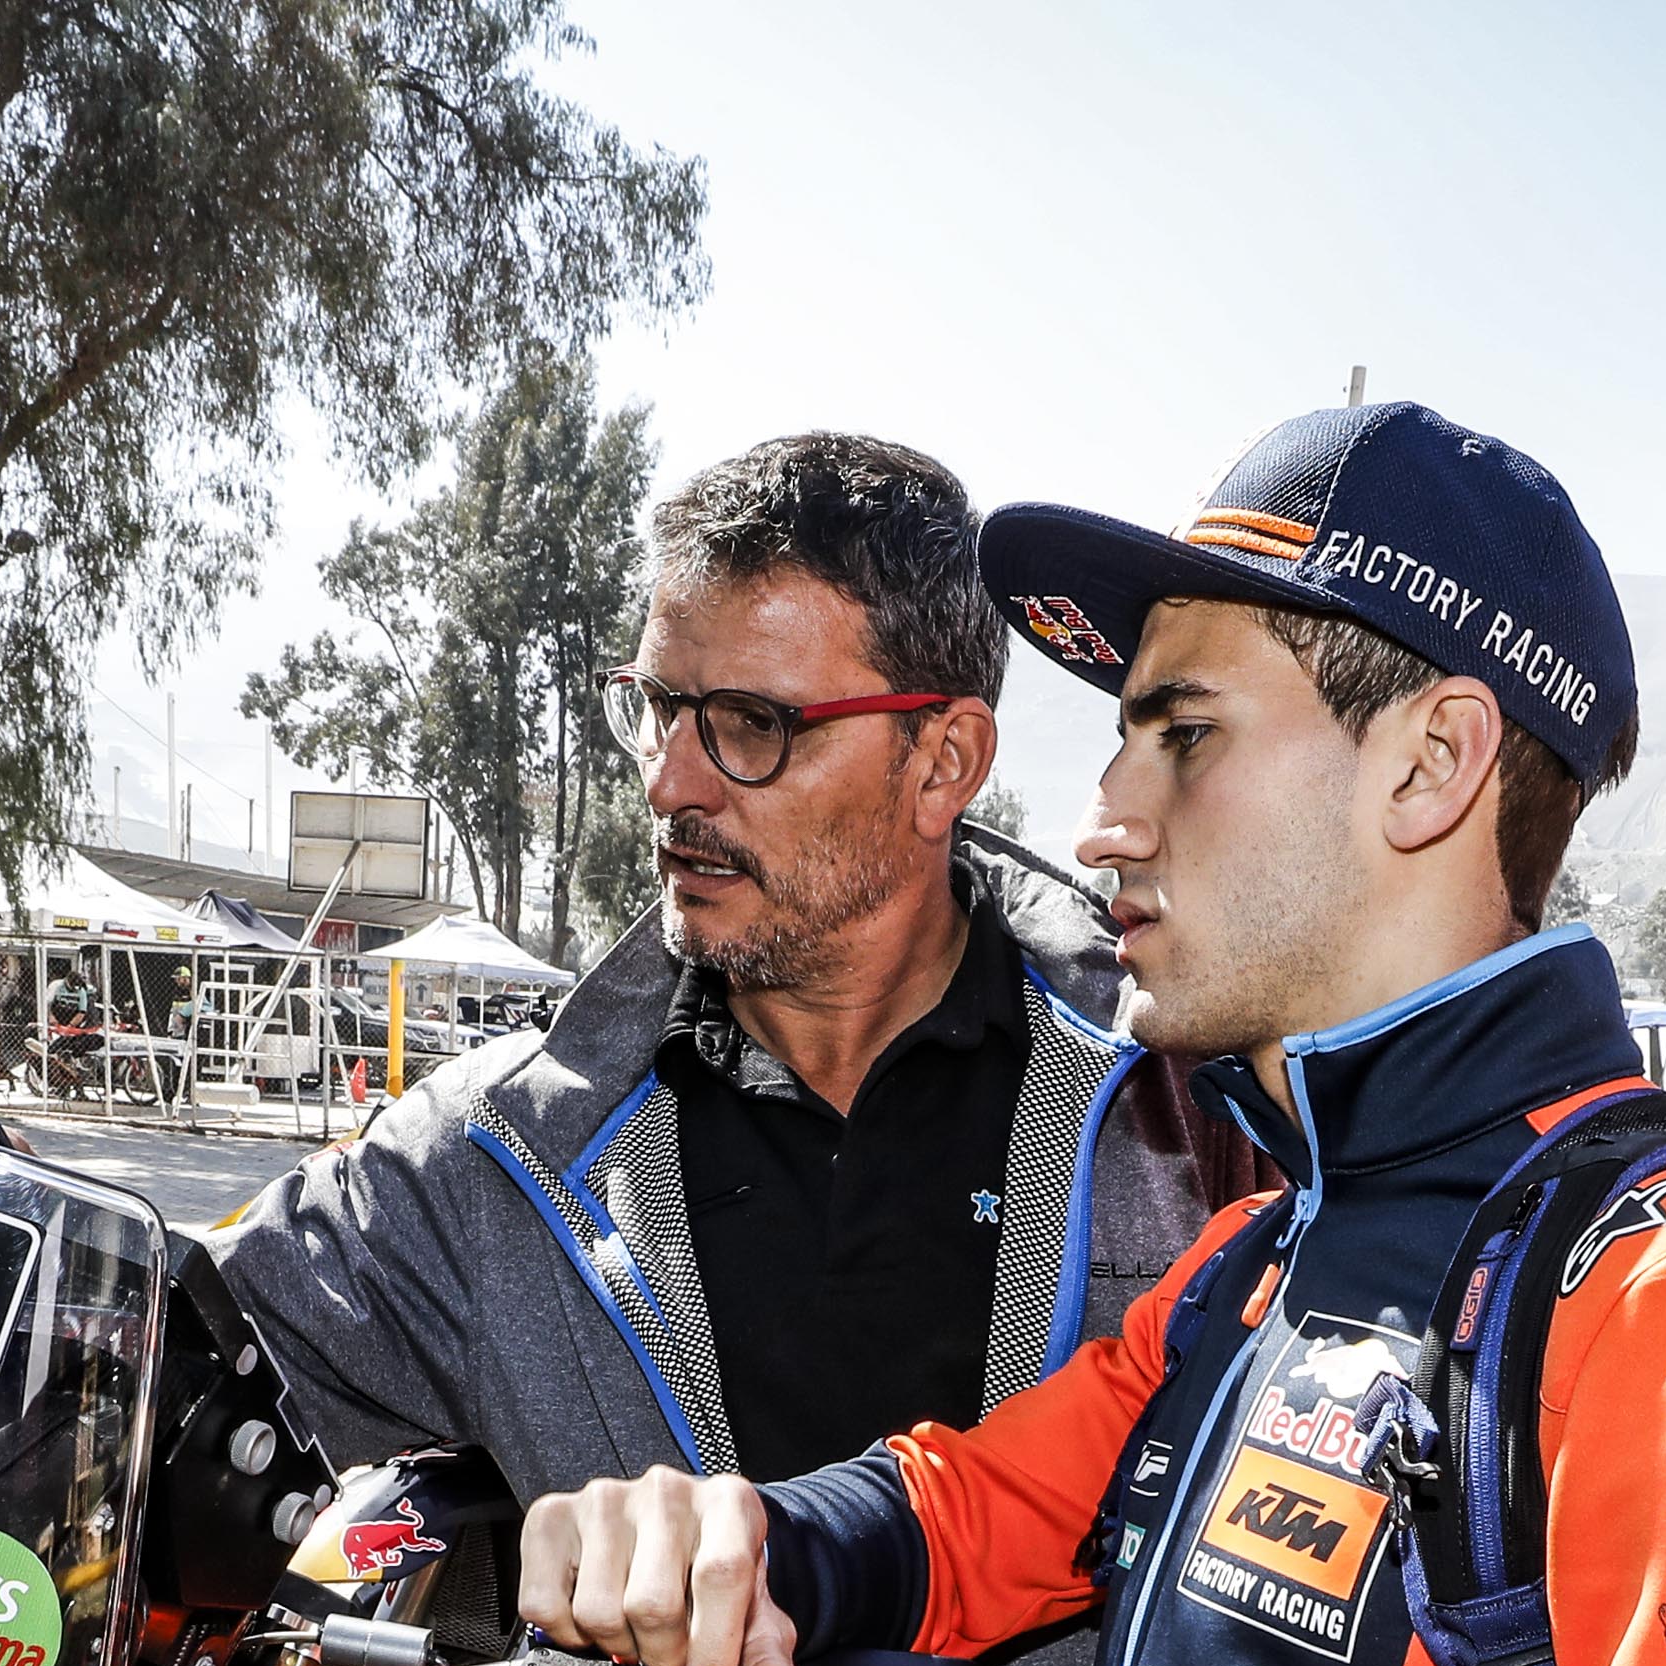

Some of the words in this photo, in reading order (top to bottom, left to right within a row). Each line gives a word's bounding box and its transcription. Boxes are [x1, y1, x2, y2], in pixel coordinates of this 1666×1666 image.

[1043, 596, 1093, 629] Bull
[1071, 630, 1125, 664] Red
[1315, 530, 1483, 631] FACTORY
[1481, 610, 1597, 726] RACING
[1454, 1267, 1488, 1343] OGIO
[1247, 1385, 1323, 1454] Red
[1314, 1398, 1371, 1476] Bu
[1226, 1482, 1349, 1563] KTM
[1186, 1551, 1258, 1607] FACTORY
[1257, 1582, 1346, 1641] RACING
